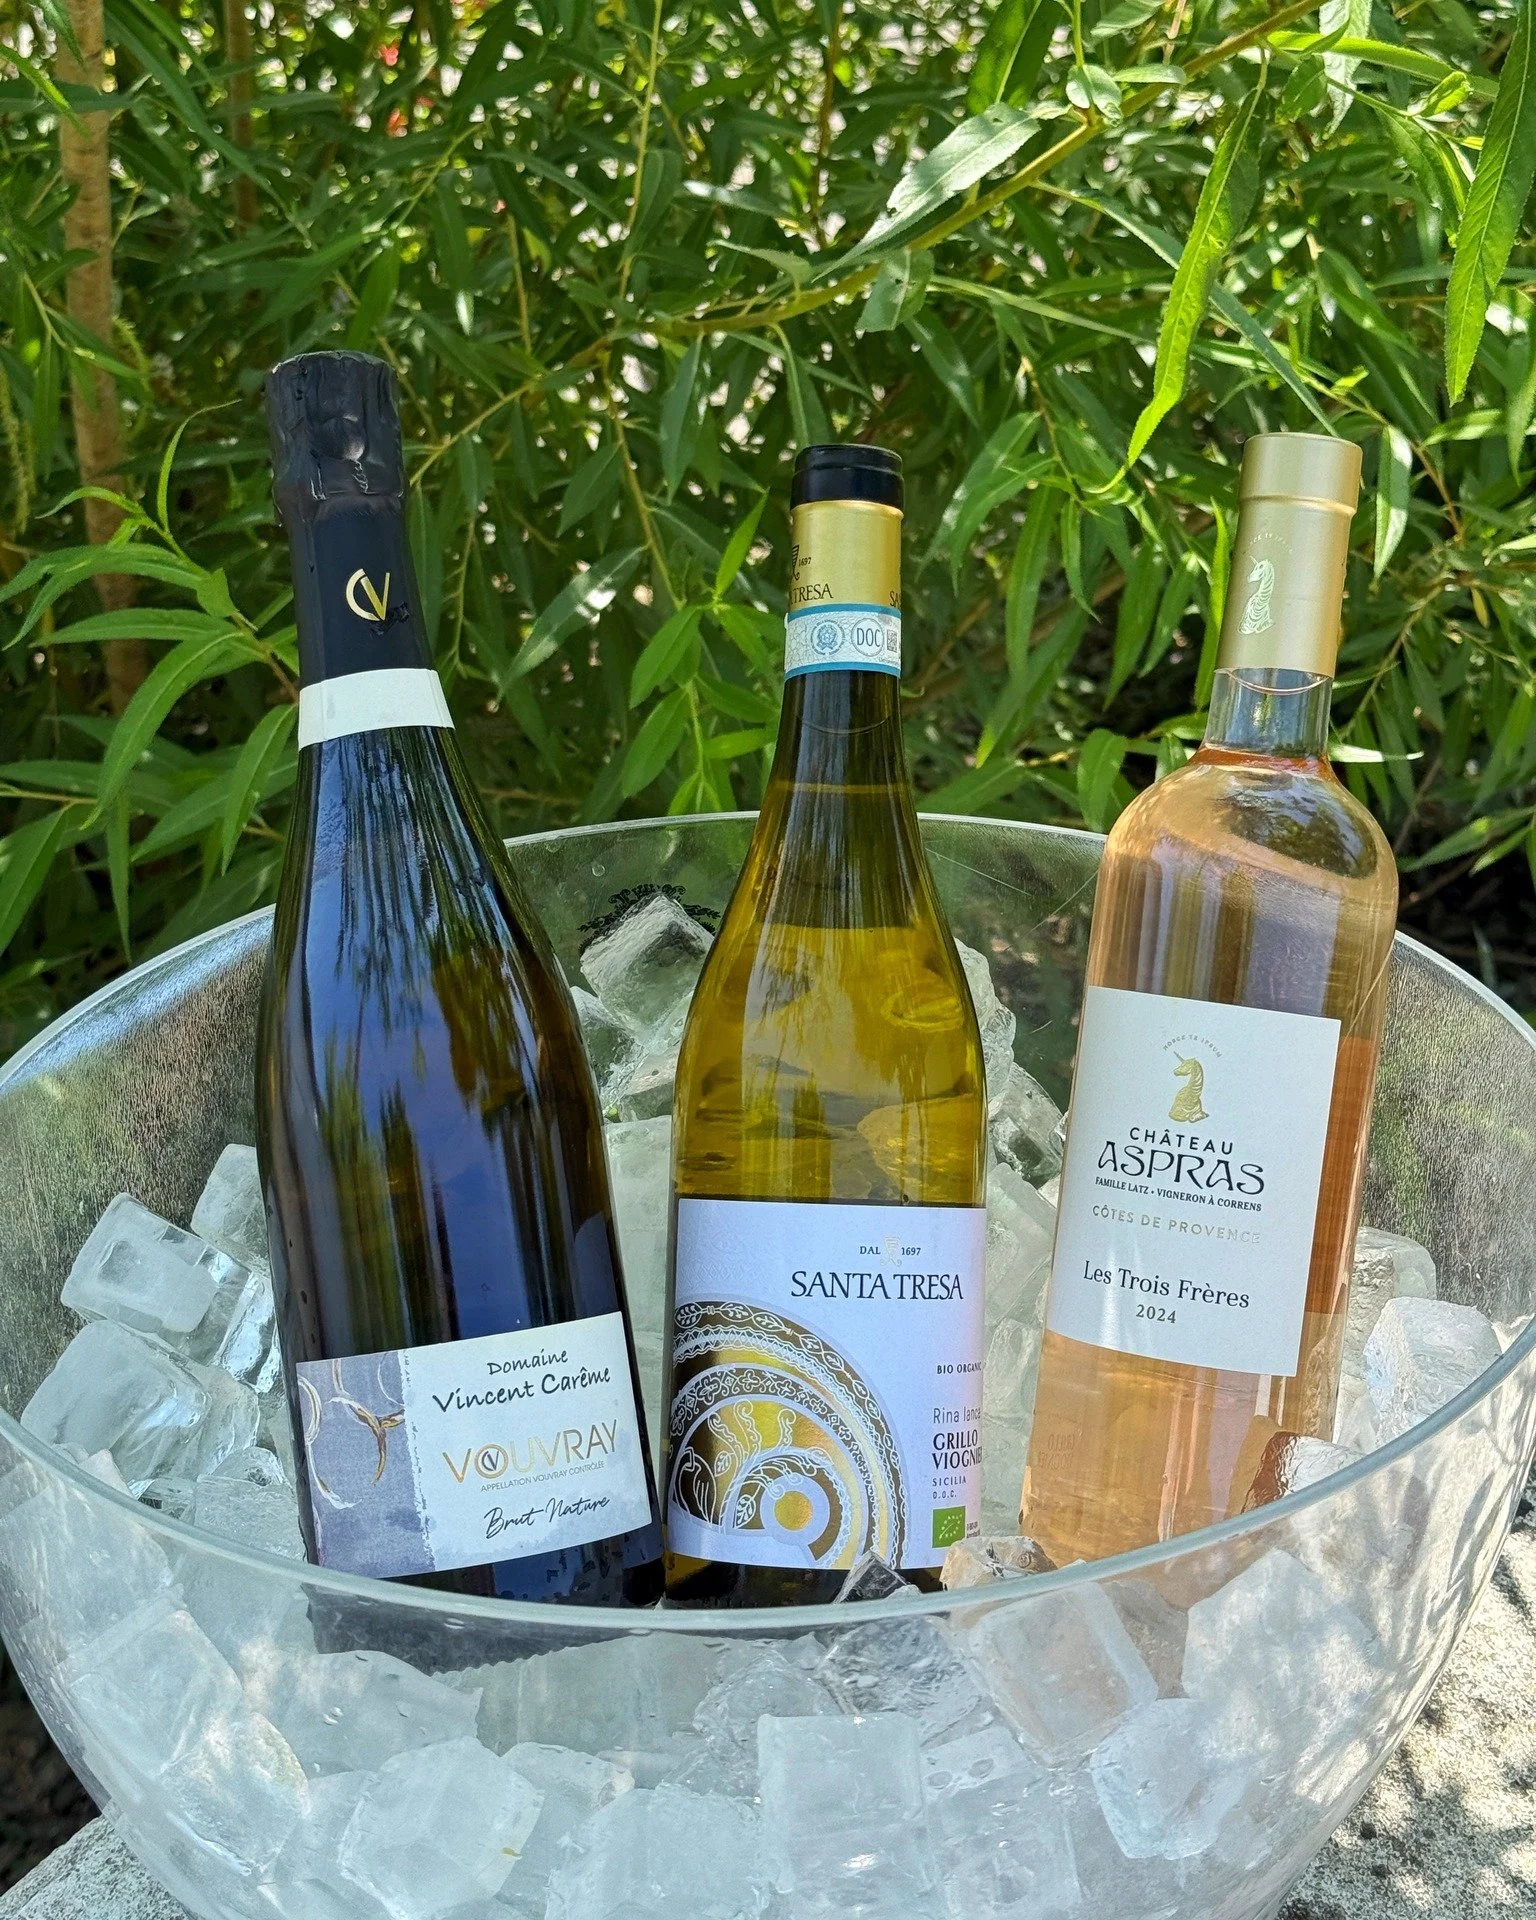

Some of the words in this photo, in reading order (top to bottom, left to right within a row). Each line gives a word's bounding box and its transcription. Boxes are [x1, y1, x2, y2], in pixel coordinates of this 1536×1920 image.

[857, 627, 880, 648] DOC
[1129, 1127, 1233, 1155] CHÂTEAU
[1097, 1141, 1265, 1195] ASPRAS
[1095, 1176, 1126, 1191] FAMILLE
[1128, 1183, 1149, 1195] LATZ
[1156, 1188, 1206, 1204] VIGNERON
[1207, 1194, 1215, 1206] À
[1217, 1197, 1262, 1212] CORRENS
[1092, 1205, 1134, 1224] CÔTES
[1141, 1214, 1161, 1229] DE
[1168, 1219, 1261, 1244] PROVENCE
[859, 1246, 881, 1255] DAL
[901, 1247, 921, 1256] 1697
[791, 1270, 891, 1300] SANTA
[893, 1273, 964, 1300] TRESA
[1083, 1260, 1112, 1285] Les
[1118, 1268, 1170, 1297] Trois
[1177, 1279, 1250, 1308] Frères
[1136, 1304, 1176, 1324] 2024
[487, 1348, 569, 1376] Domaine
[937, 1365, 953, 1375] BIO
[432, 1380, 535, 1413] Vincent
[541, 1365, 612, 1394] Carême
[933, 1407, 960, 1424] Rina
[442, 1419, 618, 1483] VOUVRAY
[932, 1429, 978, 1451] GRILLO
[480, 1476, 532, 1492] APPELLATION
[534, 1468, 568, 1483] VOUVRAY
[932, 1475, 967, 1487] SICILIA
[484, 1506, 544, 1539] Brut
[545, 1496, 610, 1523] Nature
